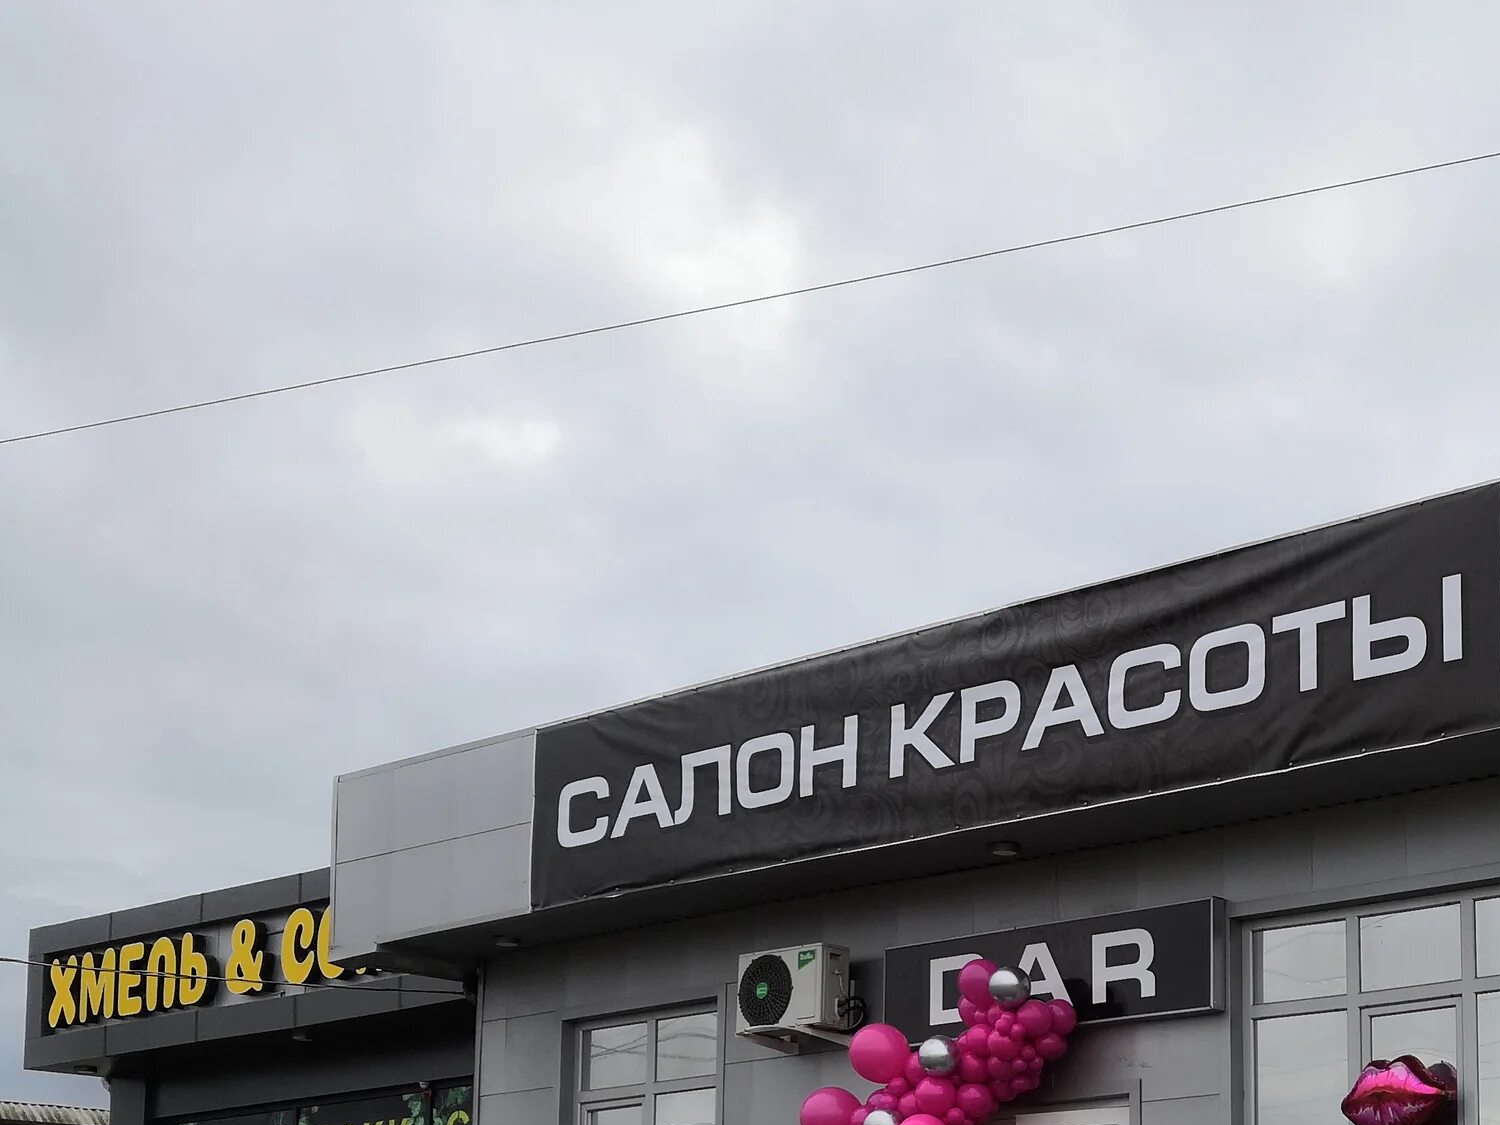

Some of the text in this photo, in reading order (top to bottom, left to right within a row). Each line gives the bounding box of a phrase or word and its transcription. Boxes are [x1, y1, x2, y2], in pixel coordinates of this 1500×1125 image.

[556, 573, 1463, 849] САЛОН КРАСОТЫ
[48, 932, 208, 1028] ХМЕЛЬ
[225, 919, 264, 995] &
[929, 928, 1156, 1026] DAR
